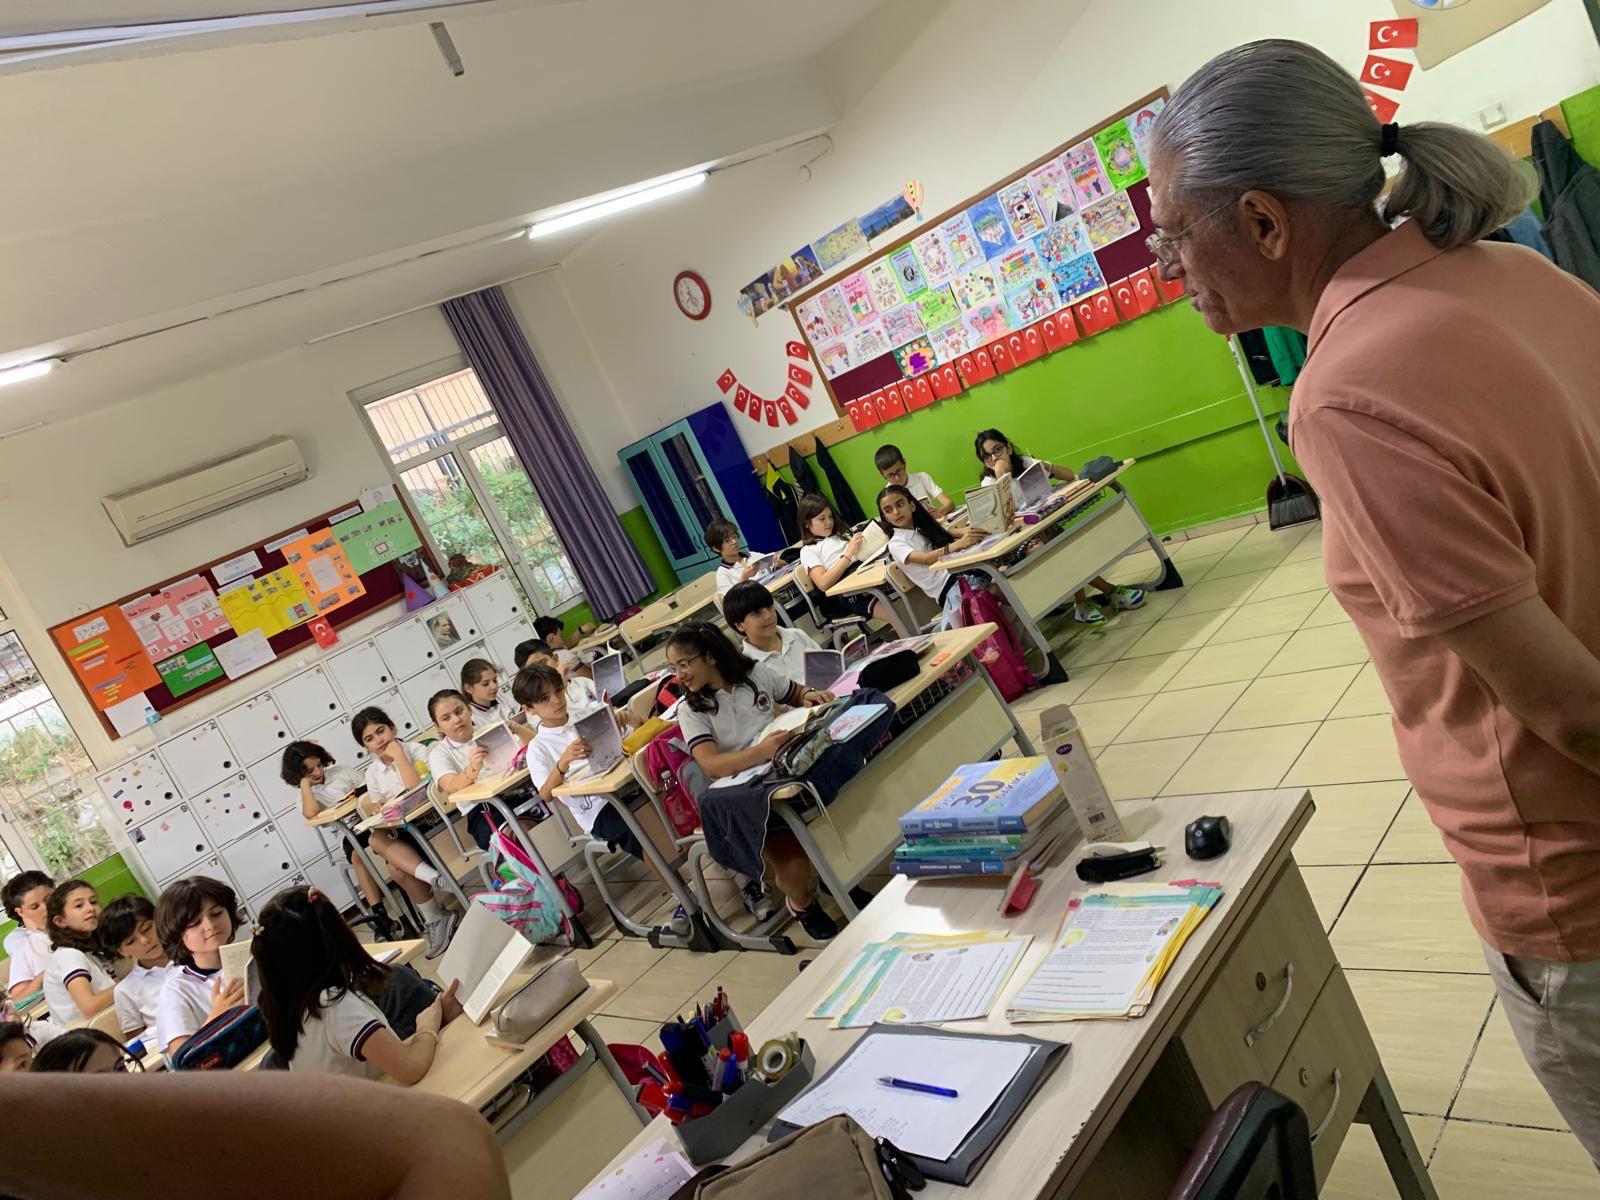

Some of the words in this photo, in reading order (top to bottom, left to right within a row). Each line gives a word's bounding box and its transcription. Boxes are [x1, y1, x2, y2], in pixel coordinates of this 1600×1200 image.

[264, 693, 272, 702] 3
[208, 722, 217, 730] 2
[950, 780, 1006, 808] 30
[263, 824, 275, 835] 18
[291, 874, 304, 886] 26
